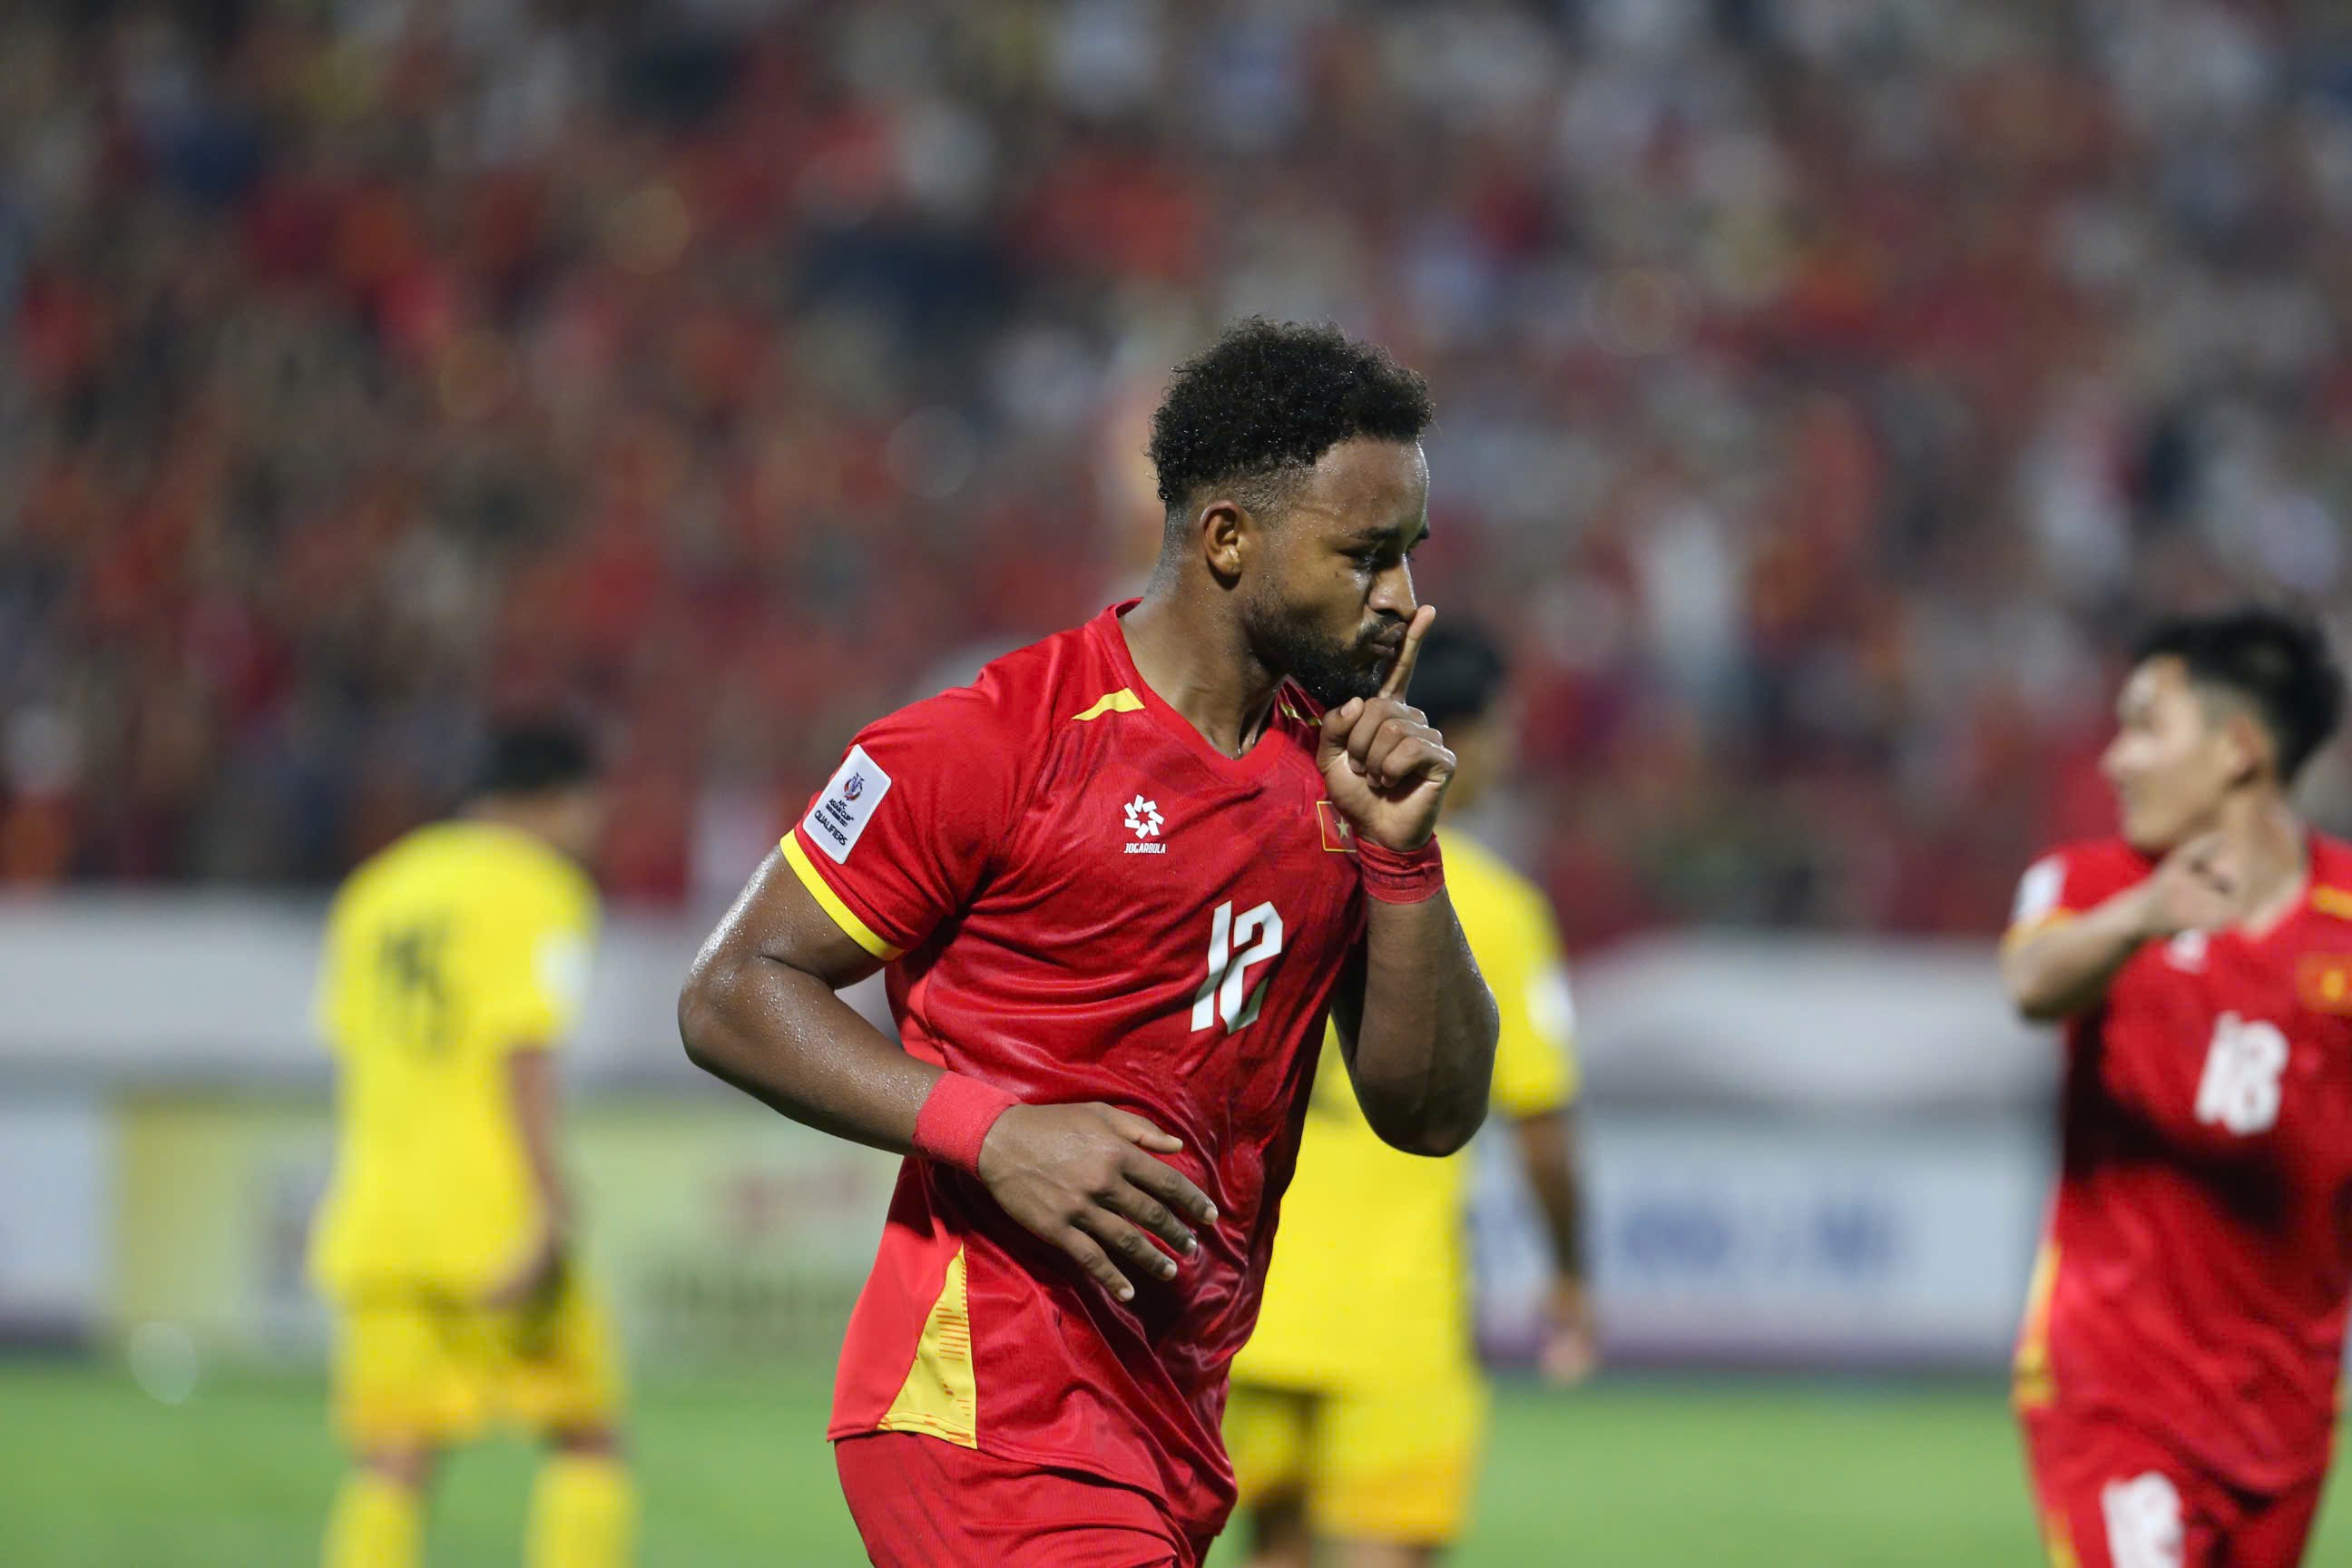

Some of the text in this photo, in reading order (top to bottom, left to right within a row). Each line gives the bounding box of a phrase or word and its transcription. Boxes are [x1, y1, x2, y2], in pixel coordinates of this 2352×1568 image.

[828, 799, 842, 813] ASIAN
[815, 809, 848, 846] QUALIFIERS
[1123, 842, 1166, 854] JOGARBOLA
[1191, 900, 1283, 1034] 12
[2194, 1010, 2289, 1136] 18
